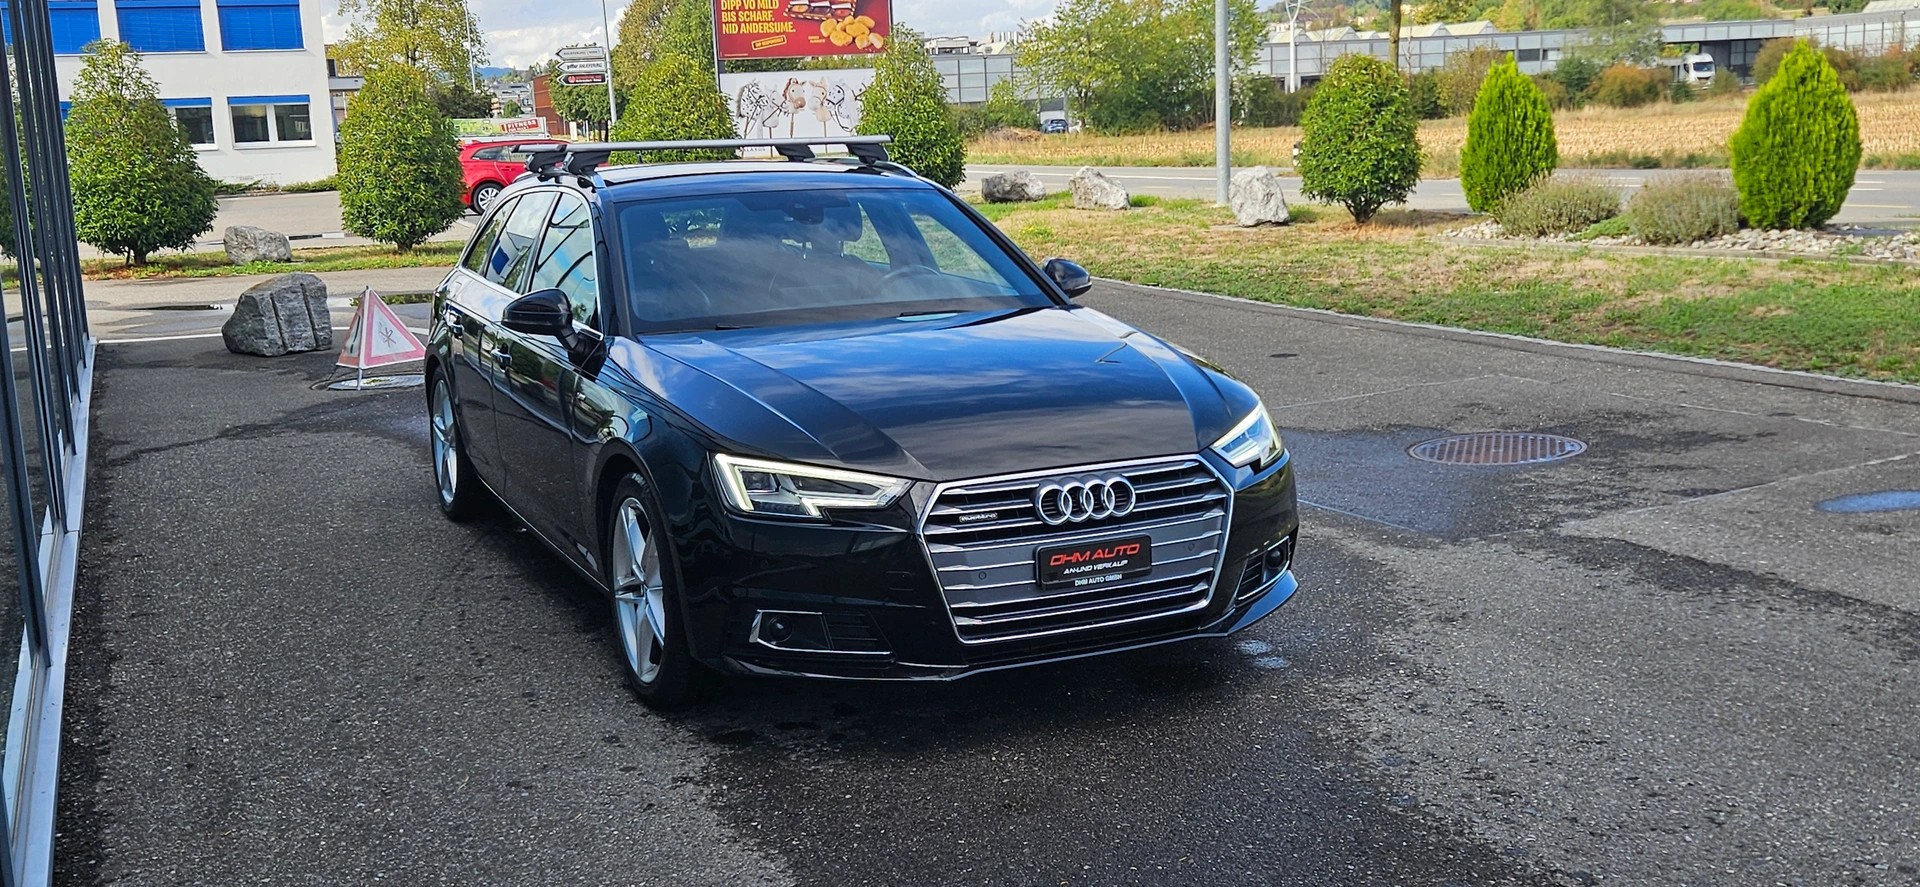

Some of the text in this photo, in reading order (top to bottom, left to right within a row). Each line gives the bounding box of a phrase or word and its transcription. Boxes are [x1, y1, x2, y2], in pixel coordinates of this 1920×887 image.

[721, 0, 779, 10] DIPP VO MILD
[721, 10, 775, 22] BIS SCHARF.
[722, 22, 796, 34] NID ANDERSUME.
[1092, 543, 1140, 560] AUTO
[1093, 559, 1129, 570] VERKAUF
